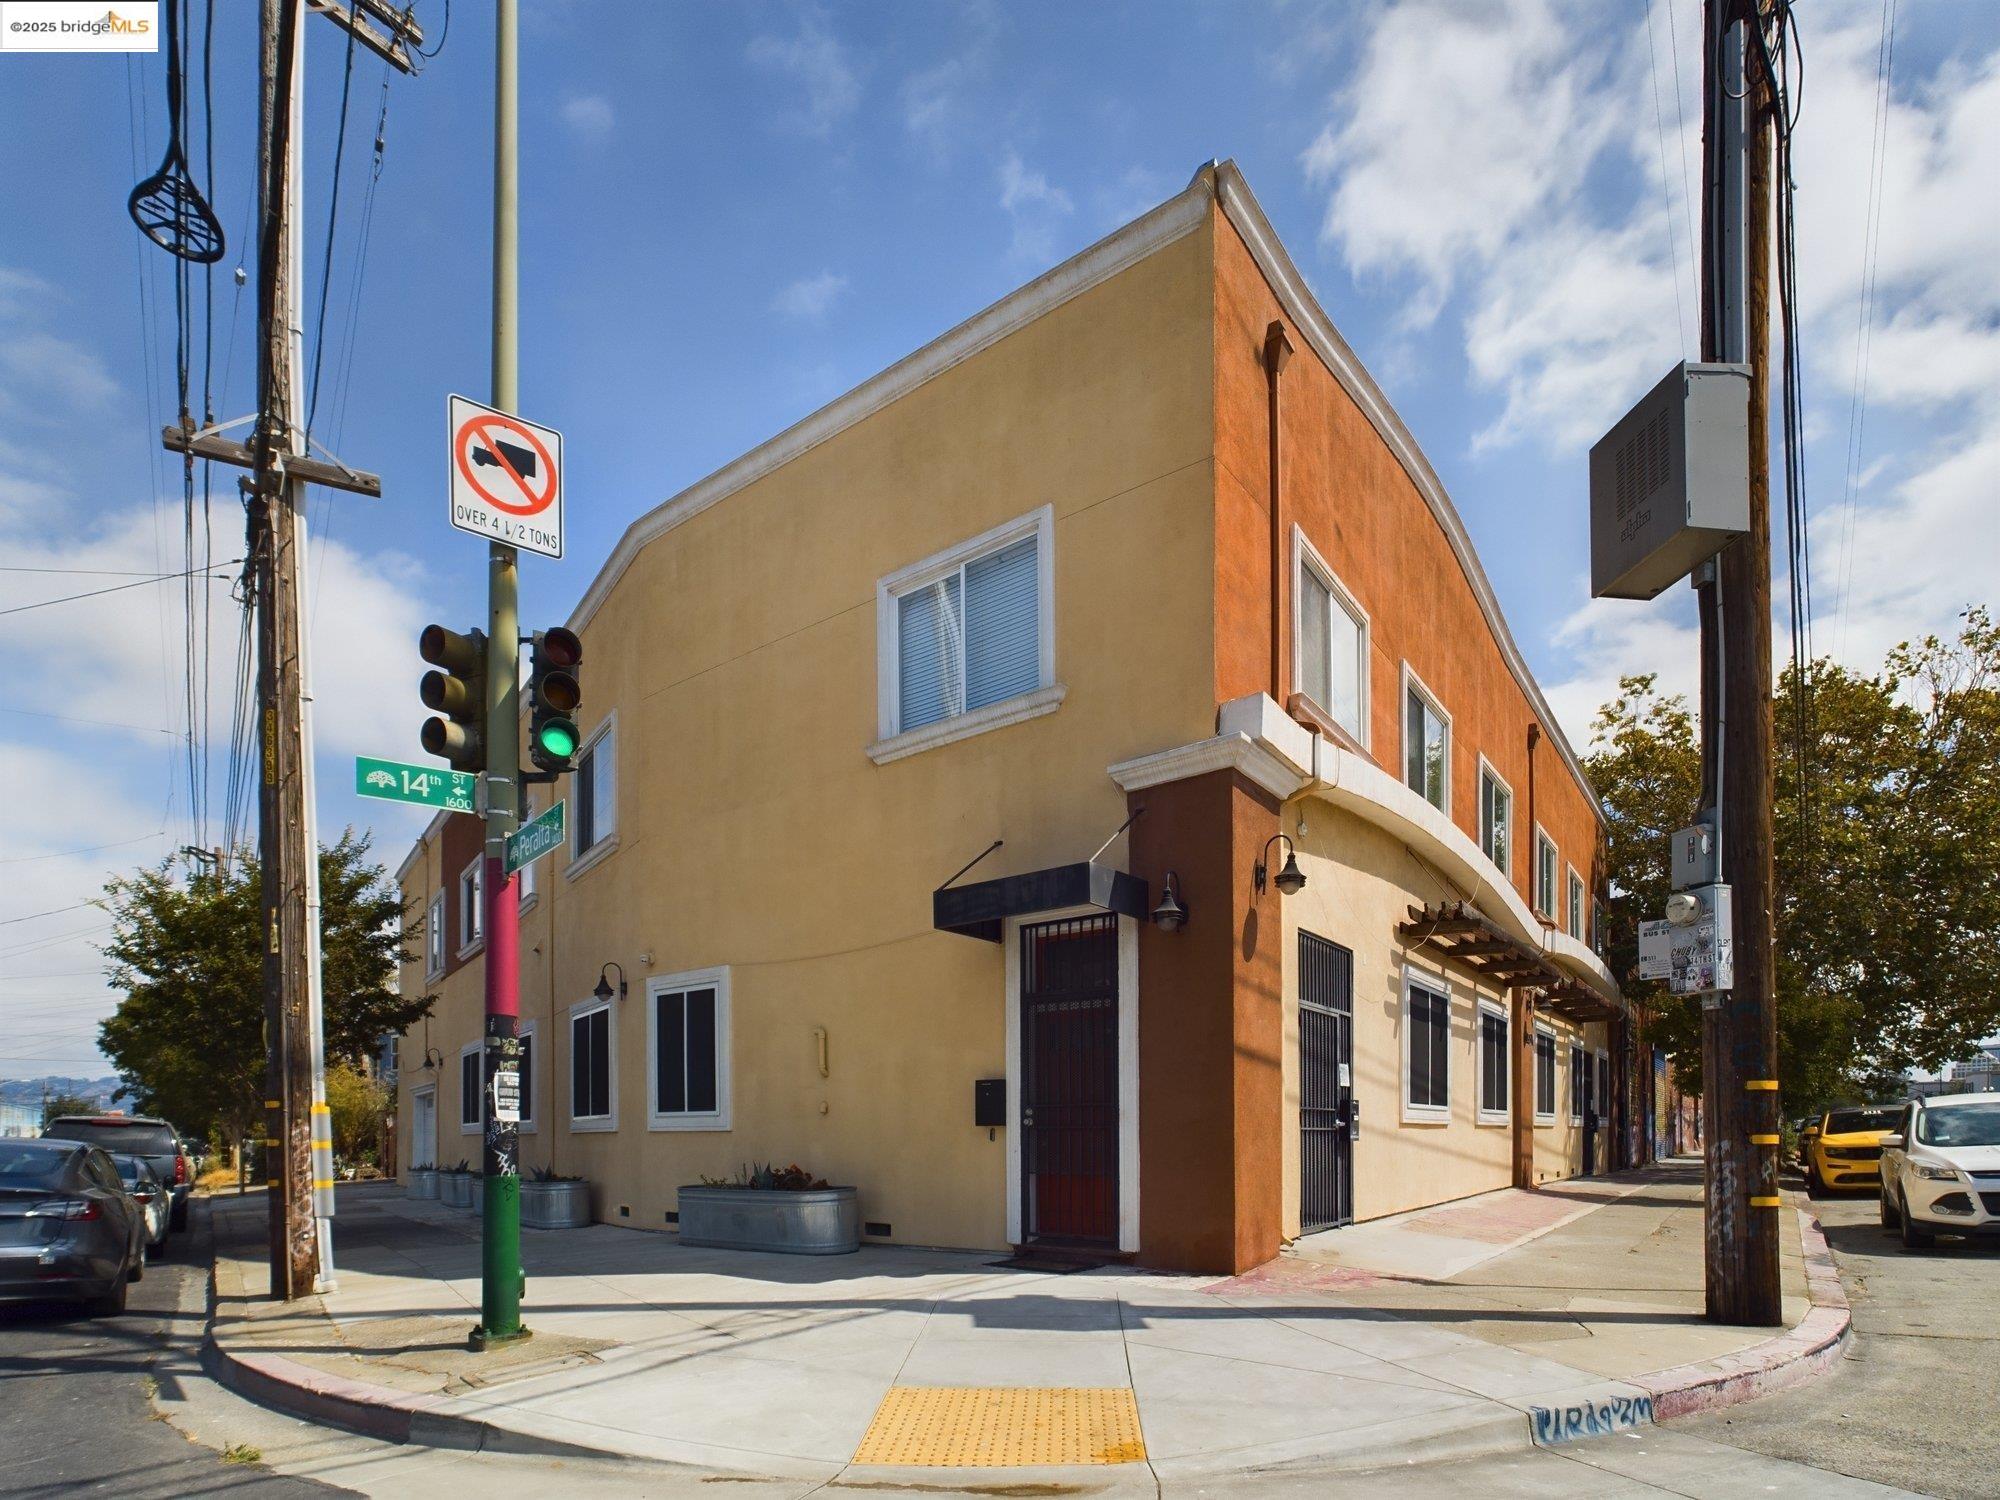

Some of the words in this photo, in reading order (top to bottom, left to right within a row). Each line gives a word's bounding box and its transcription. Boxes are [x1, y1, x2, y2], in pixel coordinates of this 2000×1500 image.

[456, 504, 487, 527] OVER
[491, 517, 499, 531] 4
[529, 528, 557, 549] TONS
[401, 770, 442, 797] 14th
[452, 773, 466, 785] ST
[445, 796, 472, 810] 1600
[519, 825, 550, 860] Peralta
